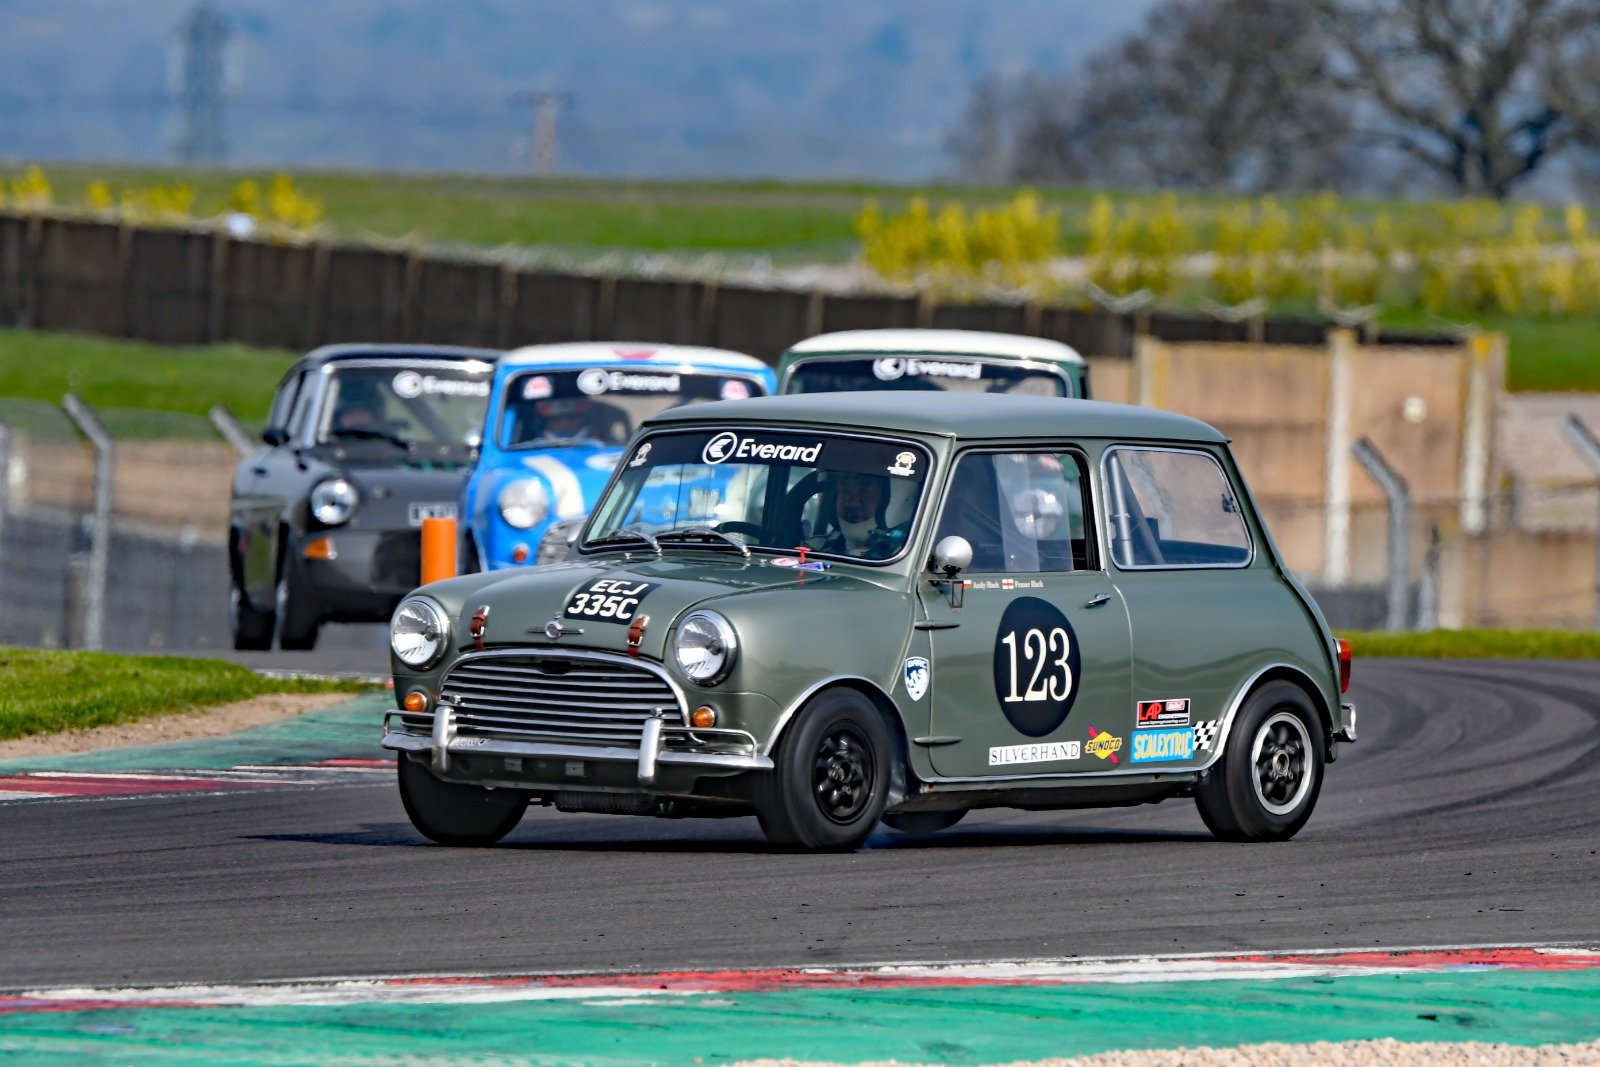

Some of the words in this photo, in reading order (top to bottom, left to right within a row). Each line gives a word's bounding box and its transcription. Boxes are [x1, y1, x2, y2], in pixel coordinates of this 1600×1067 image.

[906, 358, 982, 379] Everard
[608, 371, 681, 392] Everard
[735, 438, 823, 463] Everard
[589, 579, 649, 596] ECJ
[567, 593, 639, 620] 335C
[1002, 627, 1073, 702] 123
[1139, 702, 1162, 720] LAP
[991, 743, 1079, 763] SILVERHAND
[1087, 739, 1121, 752] SUNOCO
[1134, 732, 1191, 759] SCALEXTRIC
